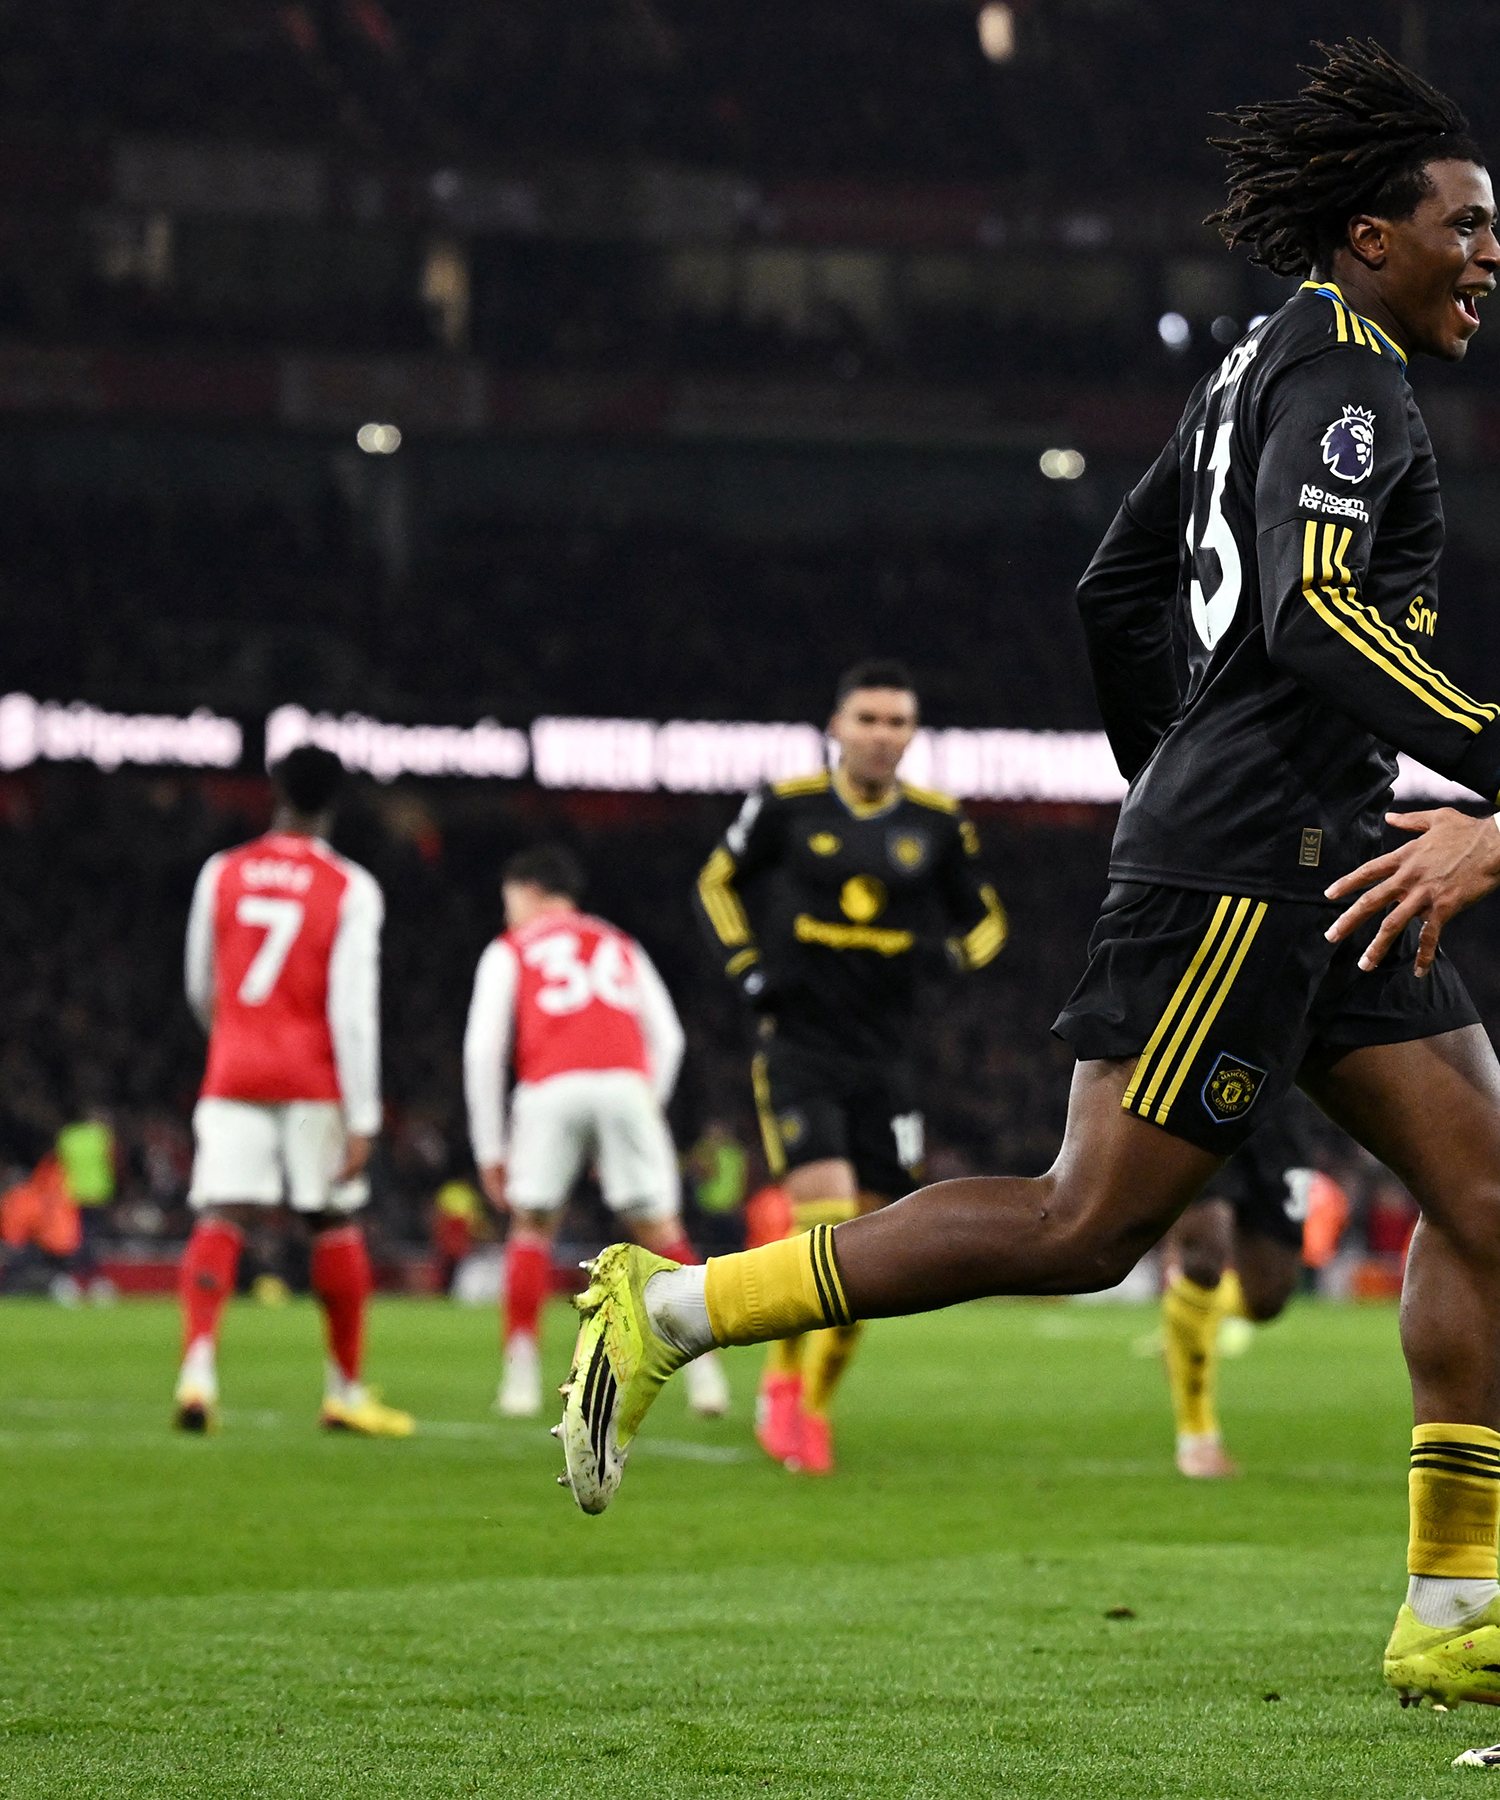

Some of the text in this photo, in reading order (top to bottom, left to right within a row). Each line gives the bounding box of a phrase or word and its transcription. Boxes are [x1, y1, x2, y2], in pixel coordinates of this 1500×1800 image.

[1299, 494, 1322, 510] for
[1300, 484, 1364, 511] No room
[236, 894, 305, 1007] 7
